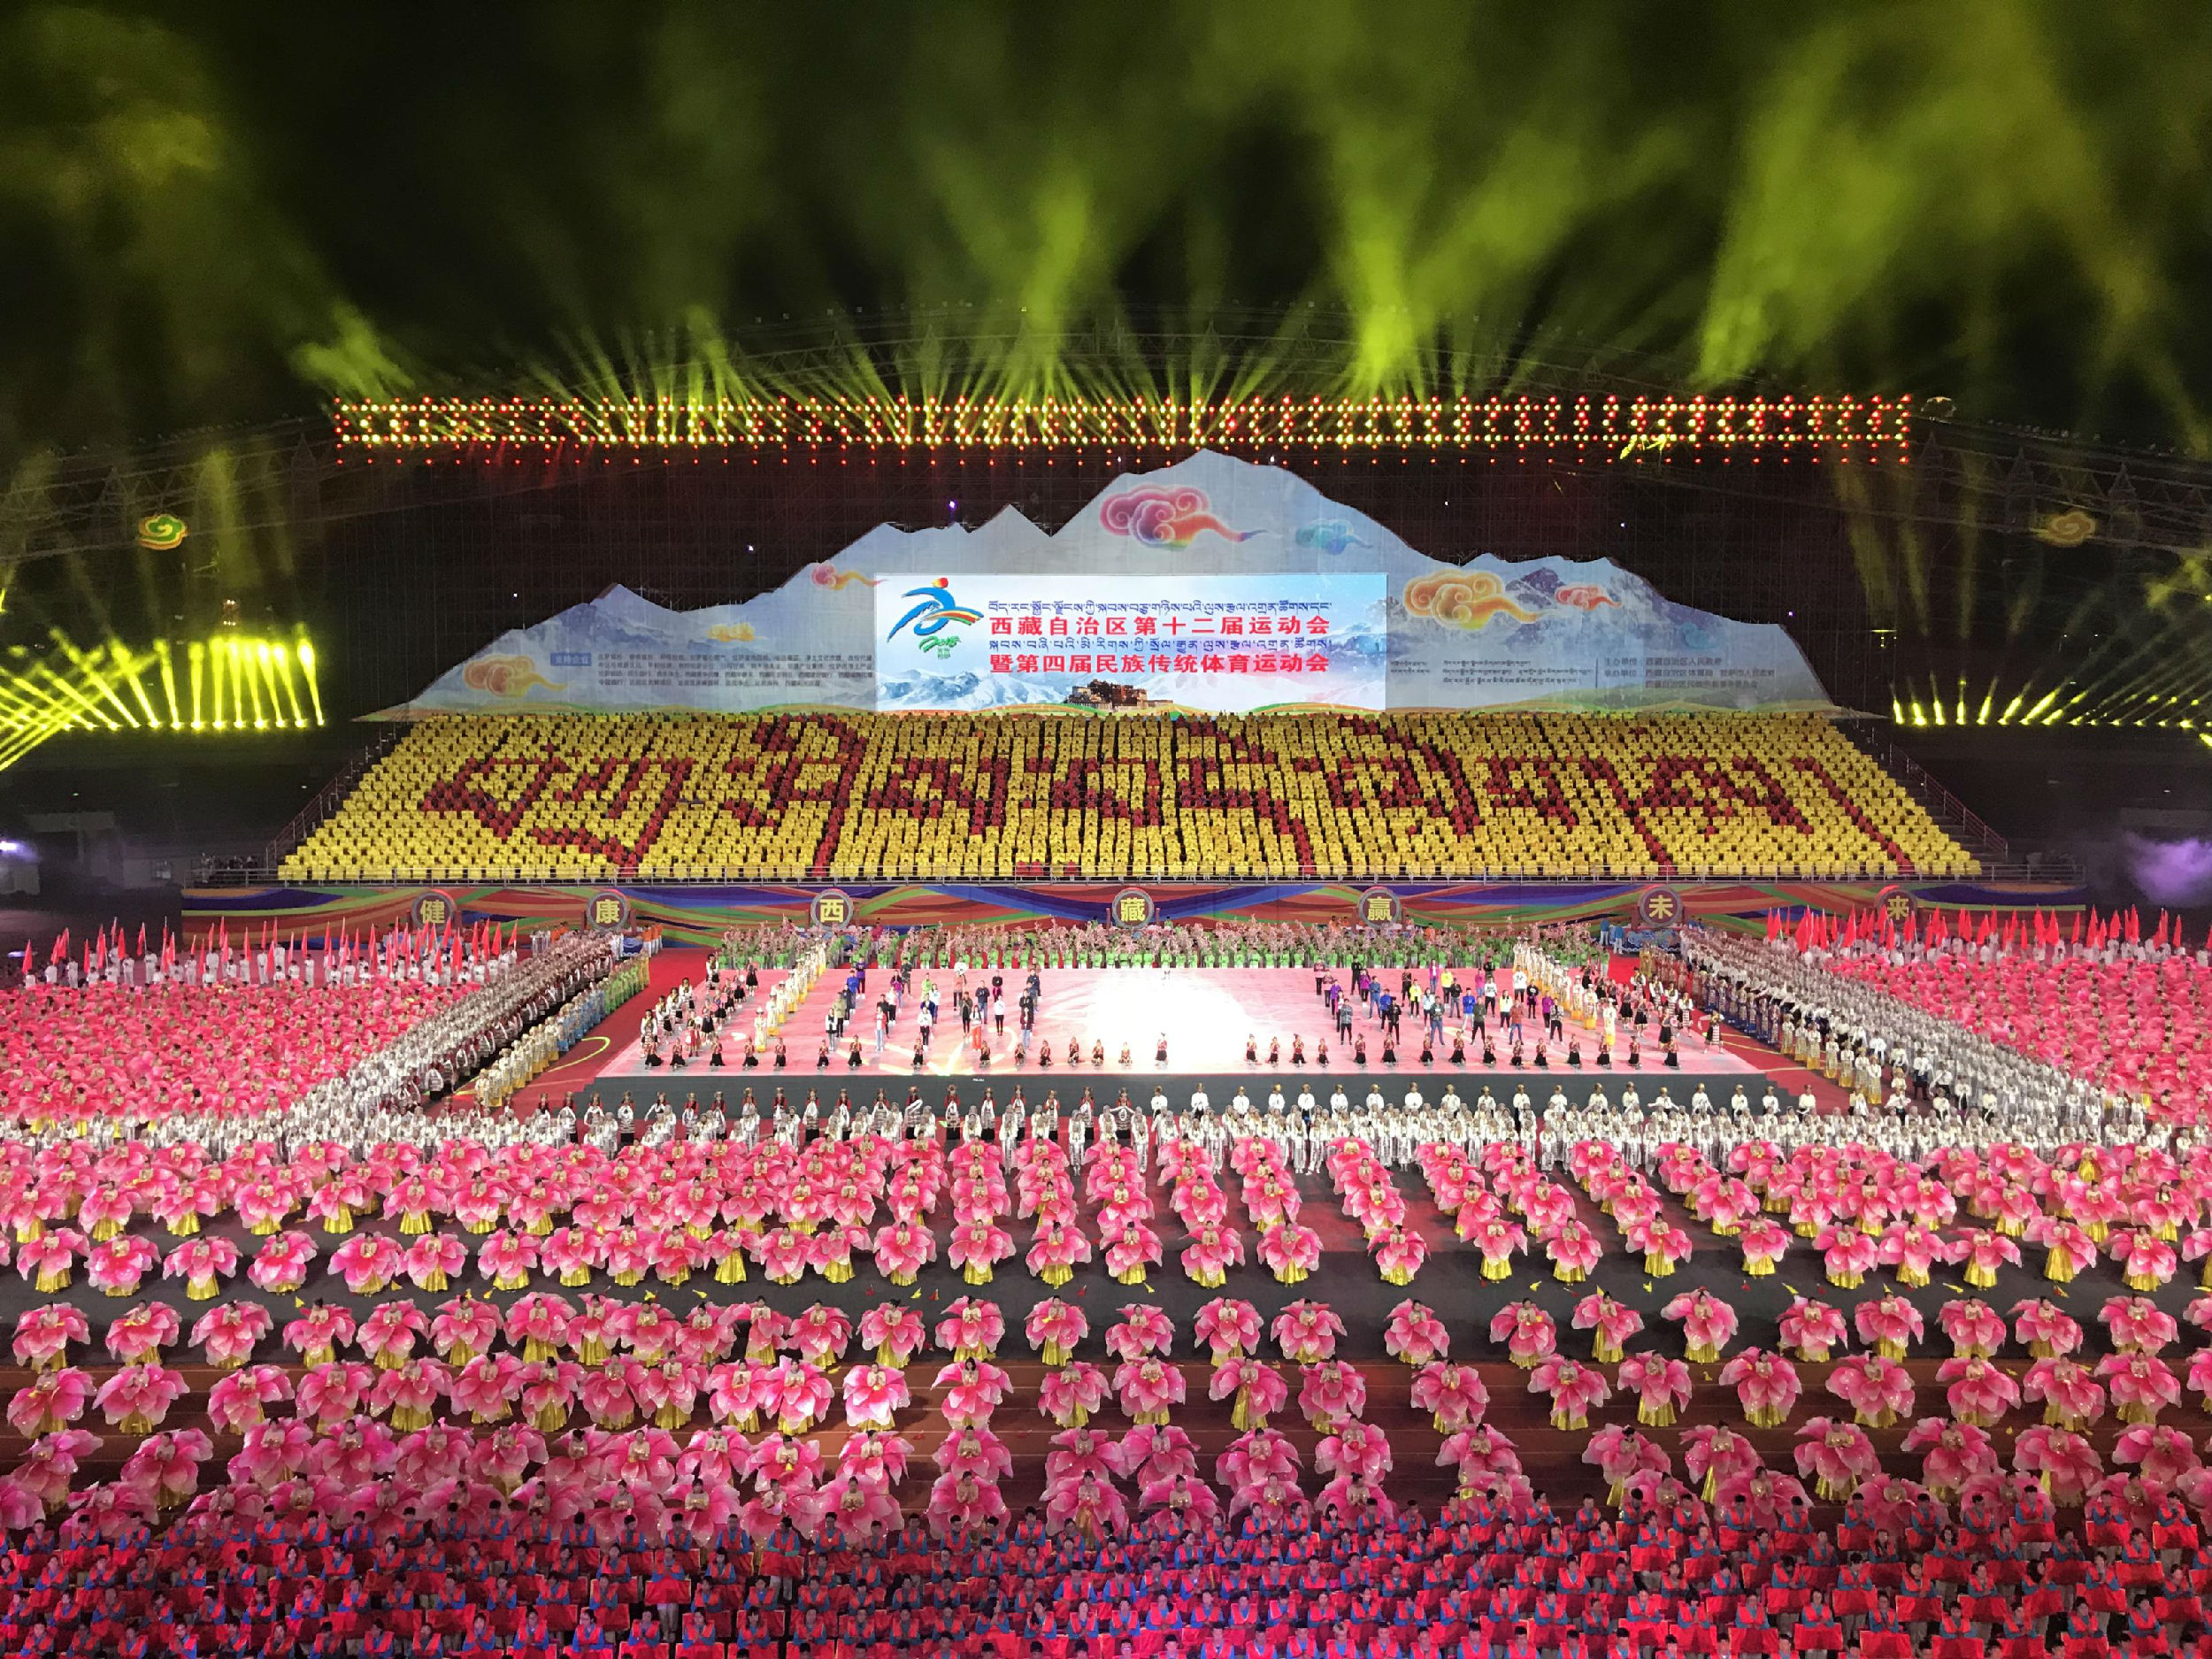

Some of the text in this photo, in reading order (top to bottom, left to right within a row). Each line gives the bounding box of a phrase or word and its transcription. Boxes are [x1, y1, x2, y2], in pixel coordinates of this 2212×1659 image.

[990, 616, 1329, 636] 西藏自治区第十二届运动会
[990, 654, 1329, 673] 暨第四届民族传统体育运动会
[419, 895, 1909, 924] 健 康 西 藏 赢 未 来
